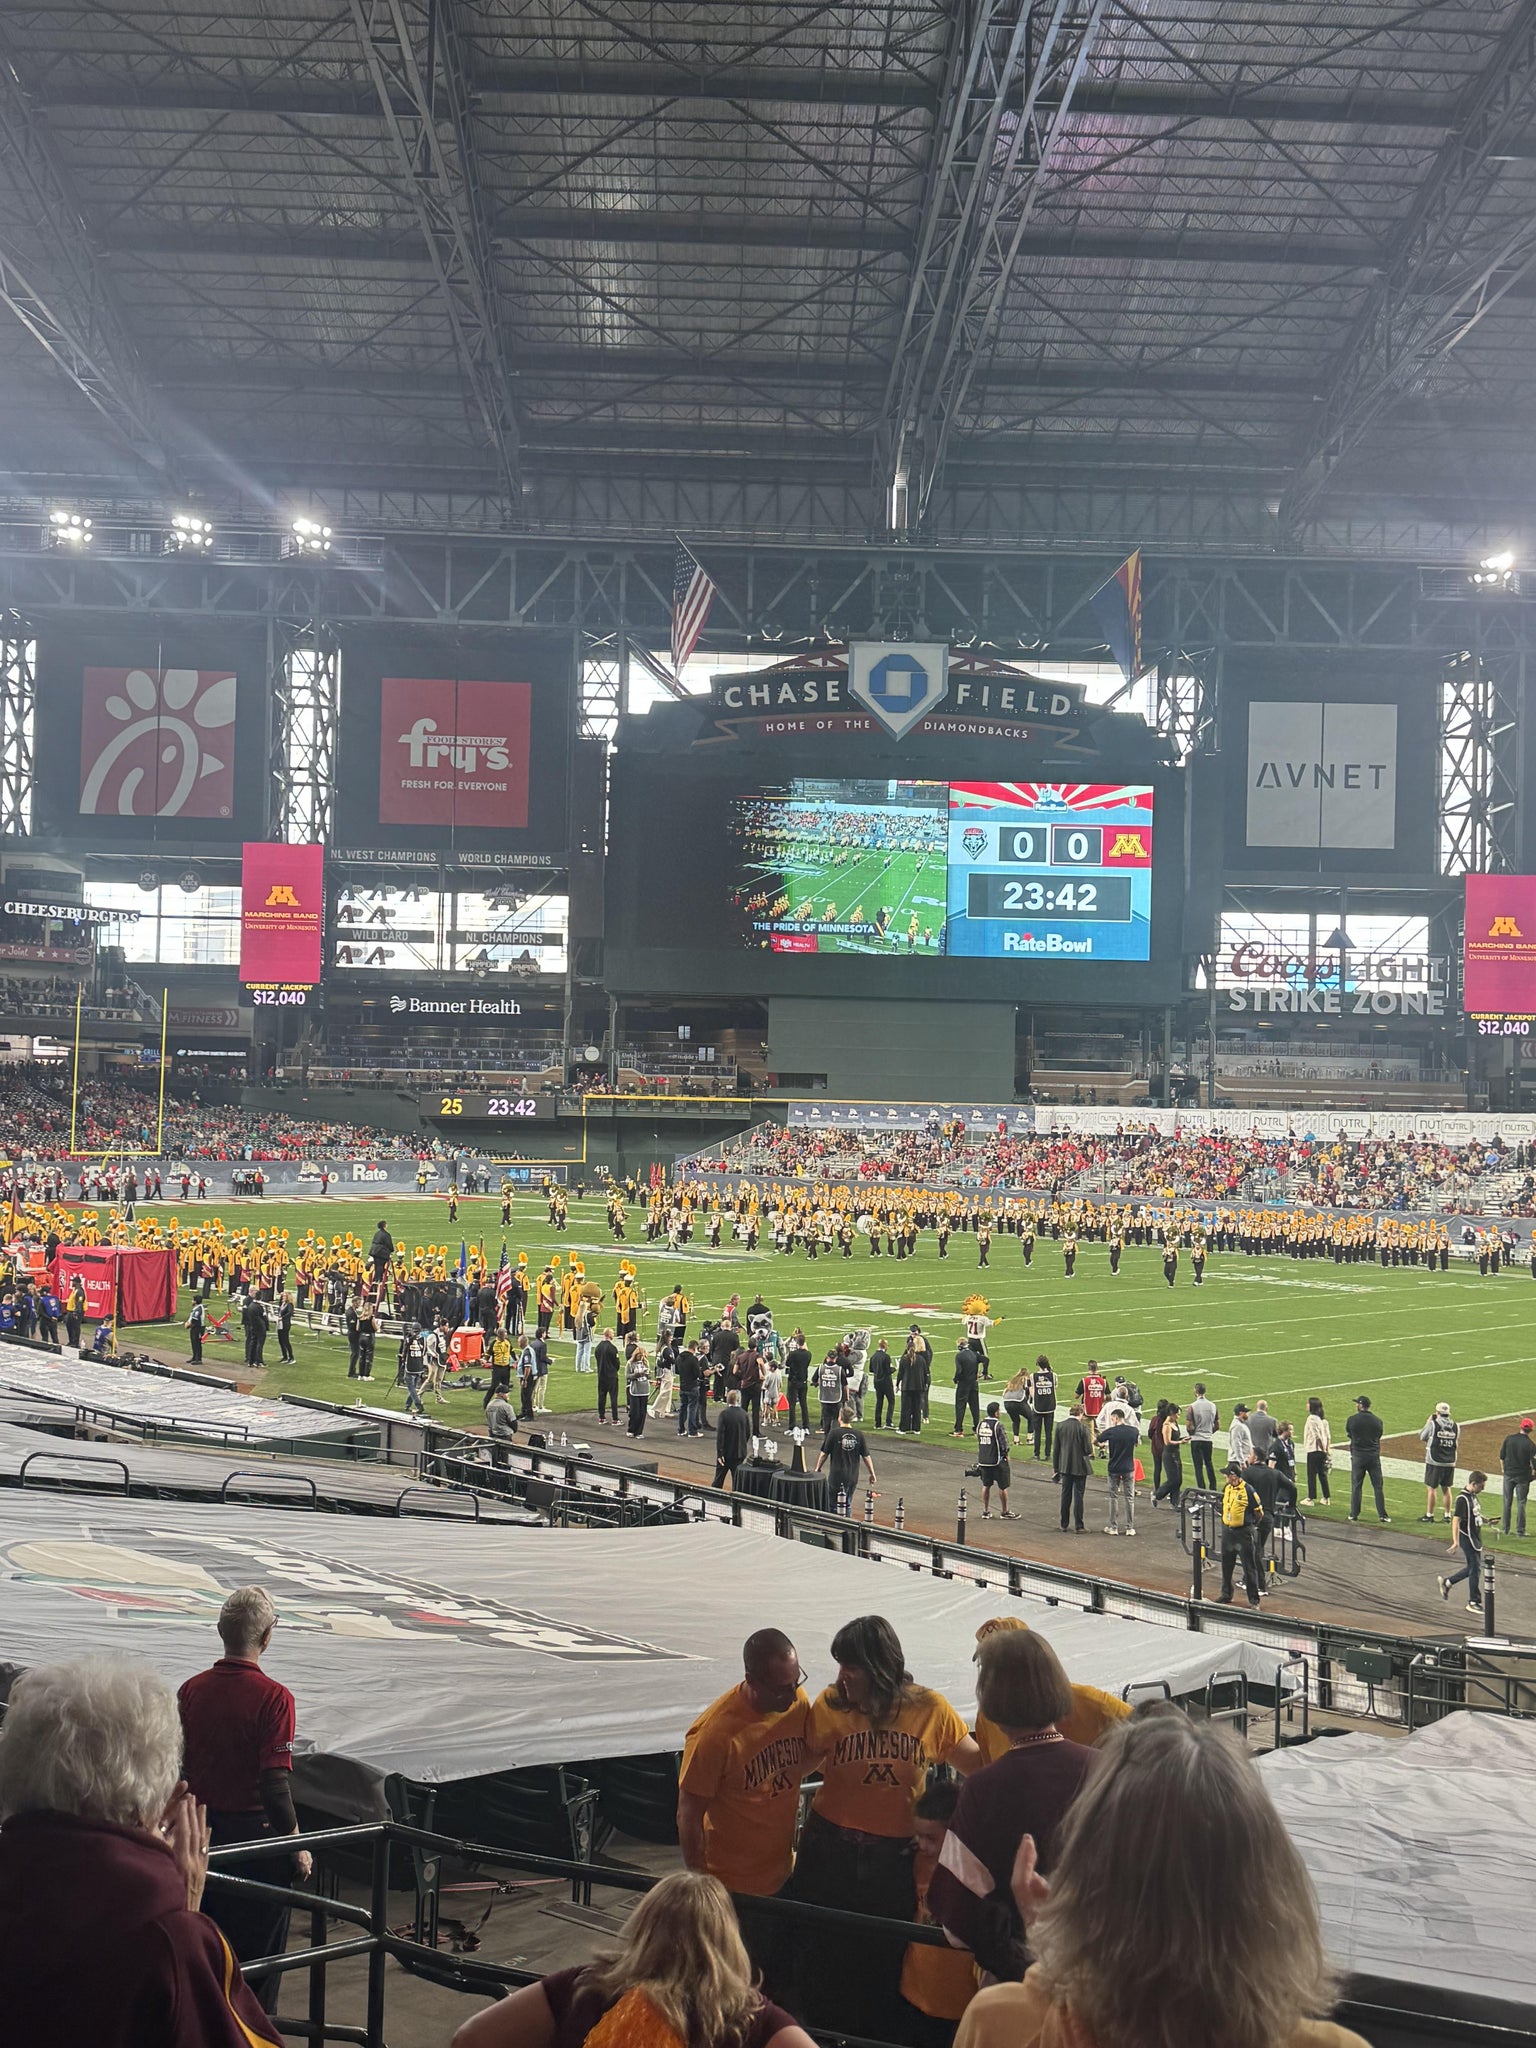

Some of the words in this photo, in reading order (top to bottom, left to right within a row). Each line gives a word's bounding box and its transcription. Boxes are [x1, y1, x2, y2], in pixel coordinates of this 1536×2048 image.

[723, 680, 840, 709] CHASE
[957, 683, 1072, 716] FIELD
[766, 721, 806, 732] HOME
[816, 721, 833, 730] OF
[844, 719, 871, 729] THE
[924, 721, 1029, 739] DIAMONDBACKS
[427, 736, 457, 744] FOOD
[462, 737, 503, 745] STORES
[1256, 762, 1387, 789] AVNET
[401, 779, 431, 789] FRESH
[434, 781, 454, 790] FOR
[458, 781, 508, 791] EVERYONE
[1013, 831, 1034, 859] 0
[1067, 833, 1089, 861] 0
[330, 850, 345, 859] NL
[347, 850, 375, 860] WEST
[378, 851, 437, 862] CHAMPIONS
[458, 853, 491, 863] WORLD
[494, 855, 552, 865] CHAMPIONS
[1003, 881, 1098, 911] 23:42
[4, 901, 139, 923] CHEESEBURGERS
[244, 911, 291, 919] MARCHING
[352, 930, 378, 940] WILD
[381, 931, 409, 941] CARD
[753, 922, 771, 931] THE
[773, 922, 800, 931] PRIDE
[802, 924, 816, 932] OF
[818, 924, 876, 934] MINNESOTA
[466, 932, 478, 942] NL
[482, 932, 543, 944] CHAMPIONS
[8, 945, 29, 957] Joint
[1231, 940, 1334, 979] Coors
[1345, 955, 1444, 983] LIGHT
[253, 990, 306, 1006] $12,040
[409, 997, 465, 1014] Banner
[470, 999, 521, 1015] Health
[1229, 986, 1341, 1012] STRIKE
[1352, 989, 1444, 1016] ZONE
[1478, 1019, 1530, 1036] $12,040
[440, 1098, 463, 1115] 25
[487, 1098, 536, 1116] 23:42
[353, 1164, 387, 1181] Rate
[593, 1165, 609, 1174] 413
[87, 1280, 111, 1290] HEALTH
[968, 1321, 978, 1335] 71
[450, 1337, 461, 1353] G
[832, 1729, 926, 1770] MINNESOTA
